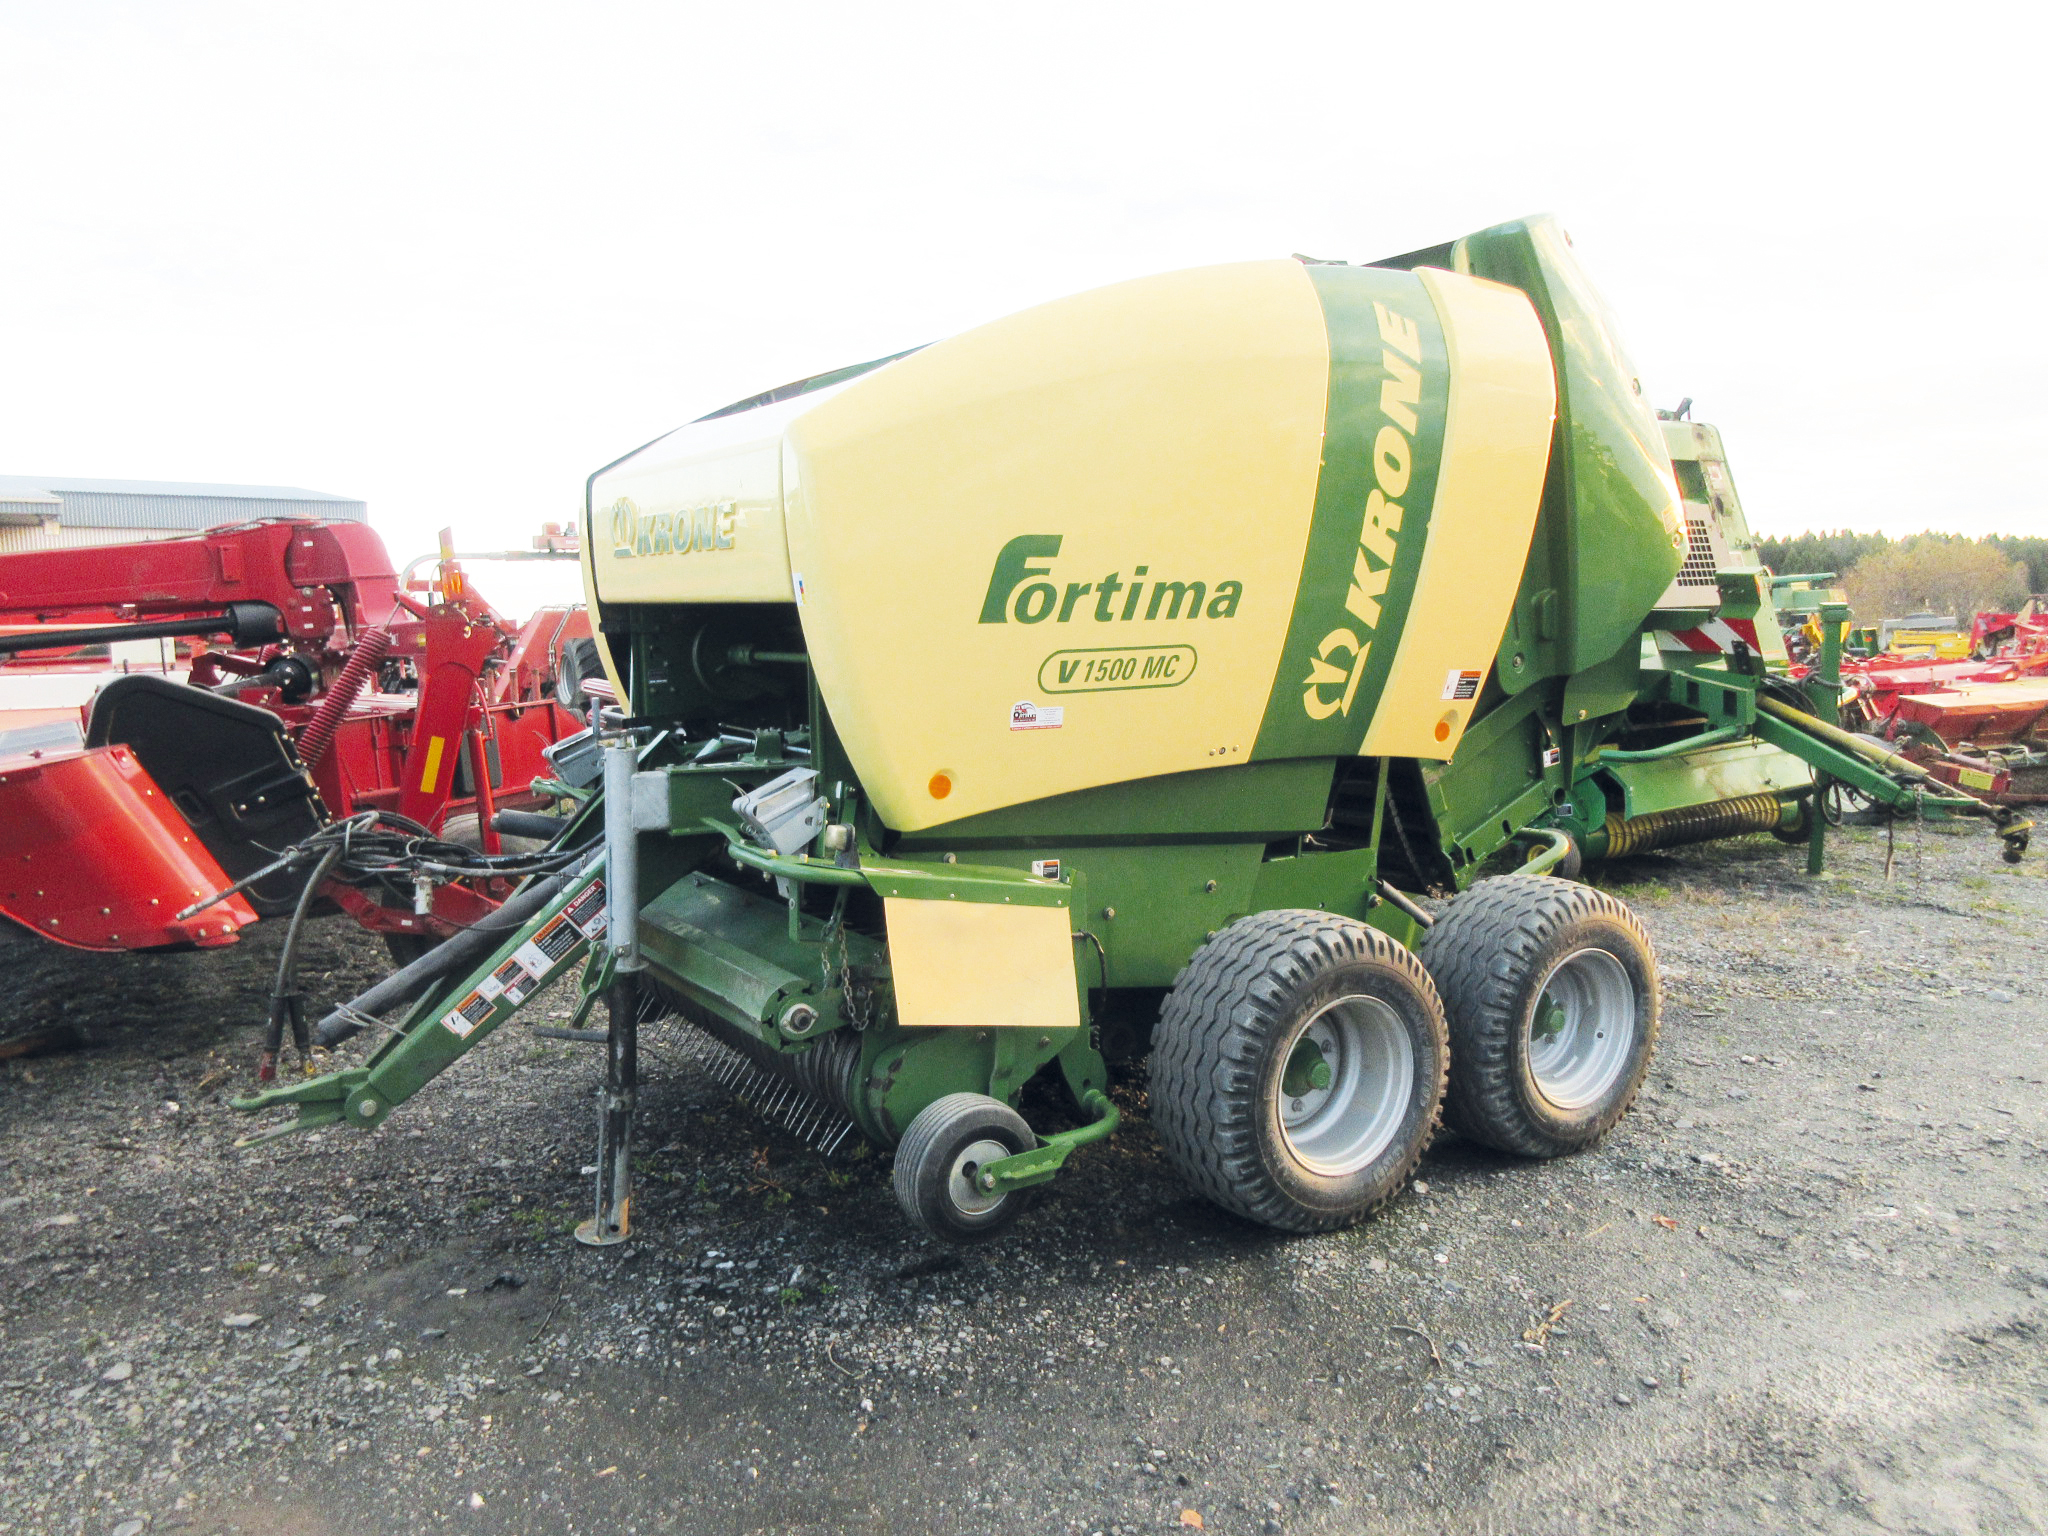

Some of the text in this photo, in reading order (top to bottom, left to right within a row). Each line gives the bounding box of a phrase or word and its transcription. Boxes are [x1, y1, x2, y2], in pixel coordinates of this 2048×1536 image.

[1345, 300, 1422, 629] KRONE
[637, 499, 738, 556] KRONE
[978, 534, 1243, 625] Fortima
[1058, 654, 1180, 684] V 1500 MC
[573, 885, 596, 907] DANGER
